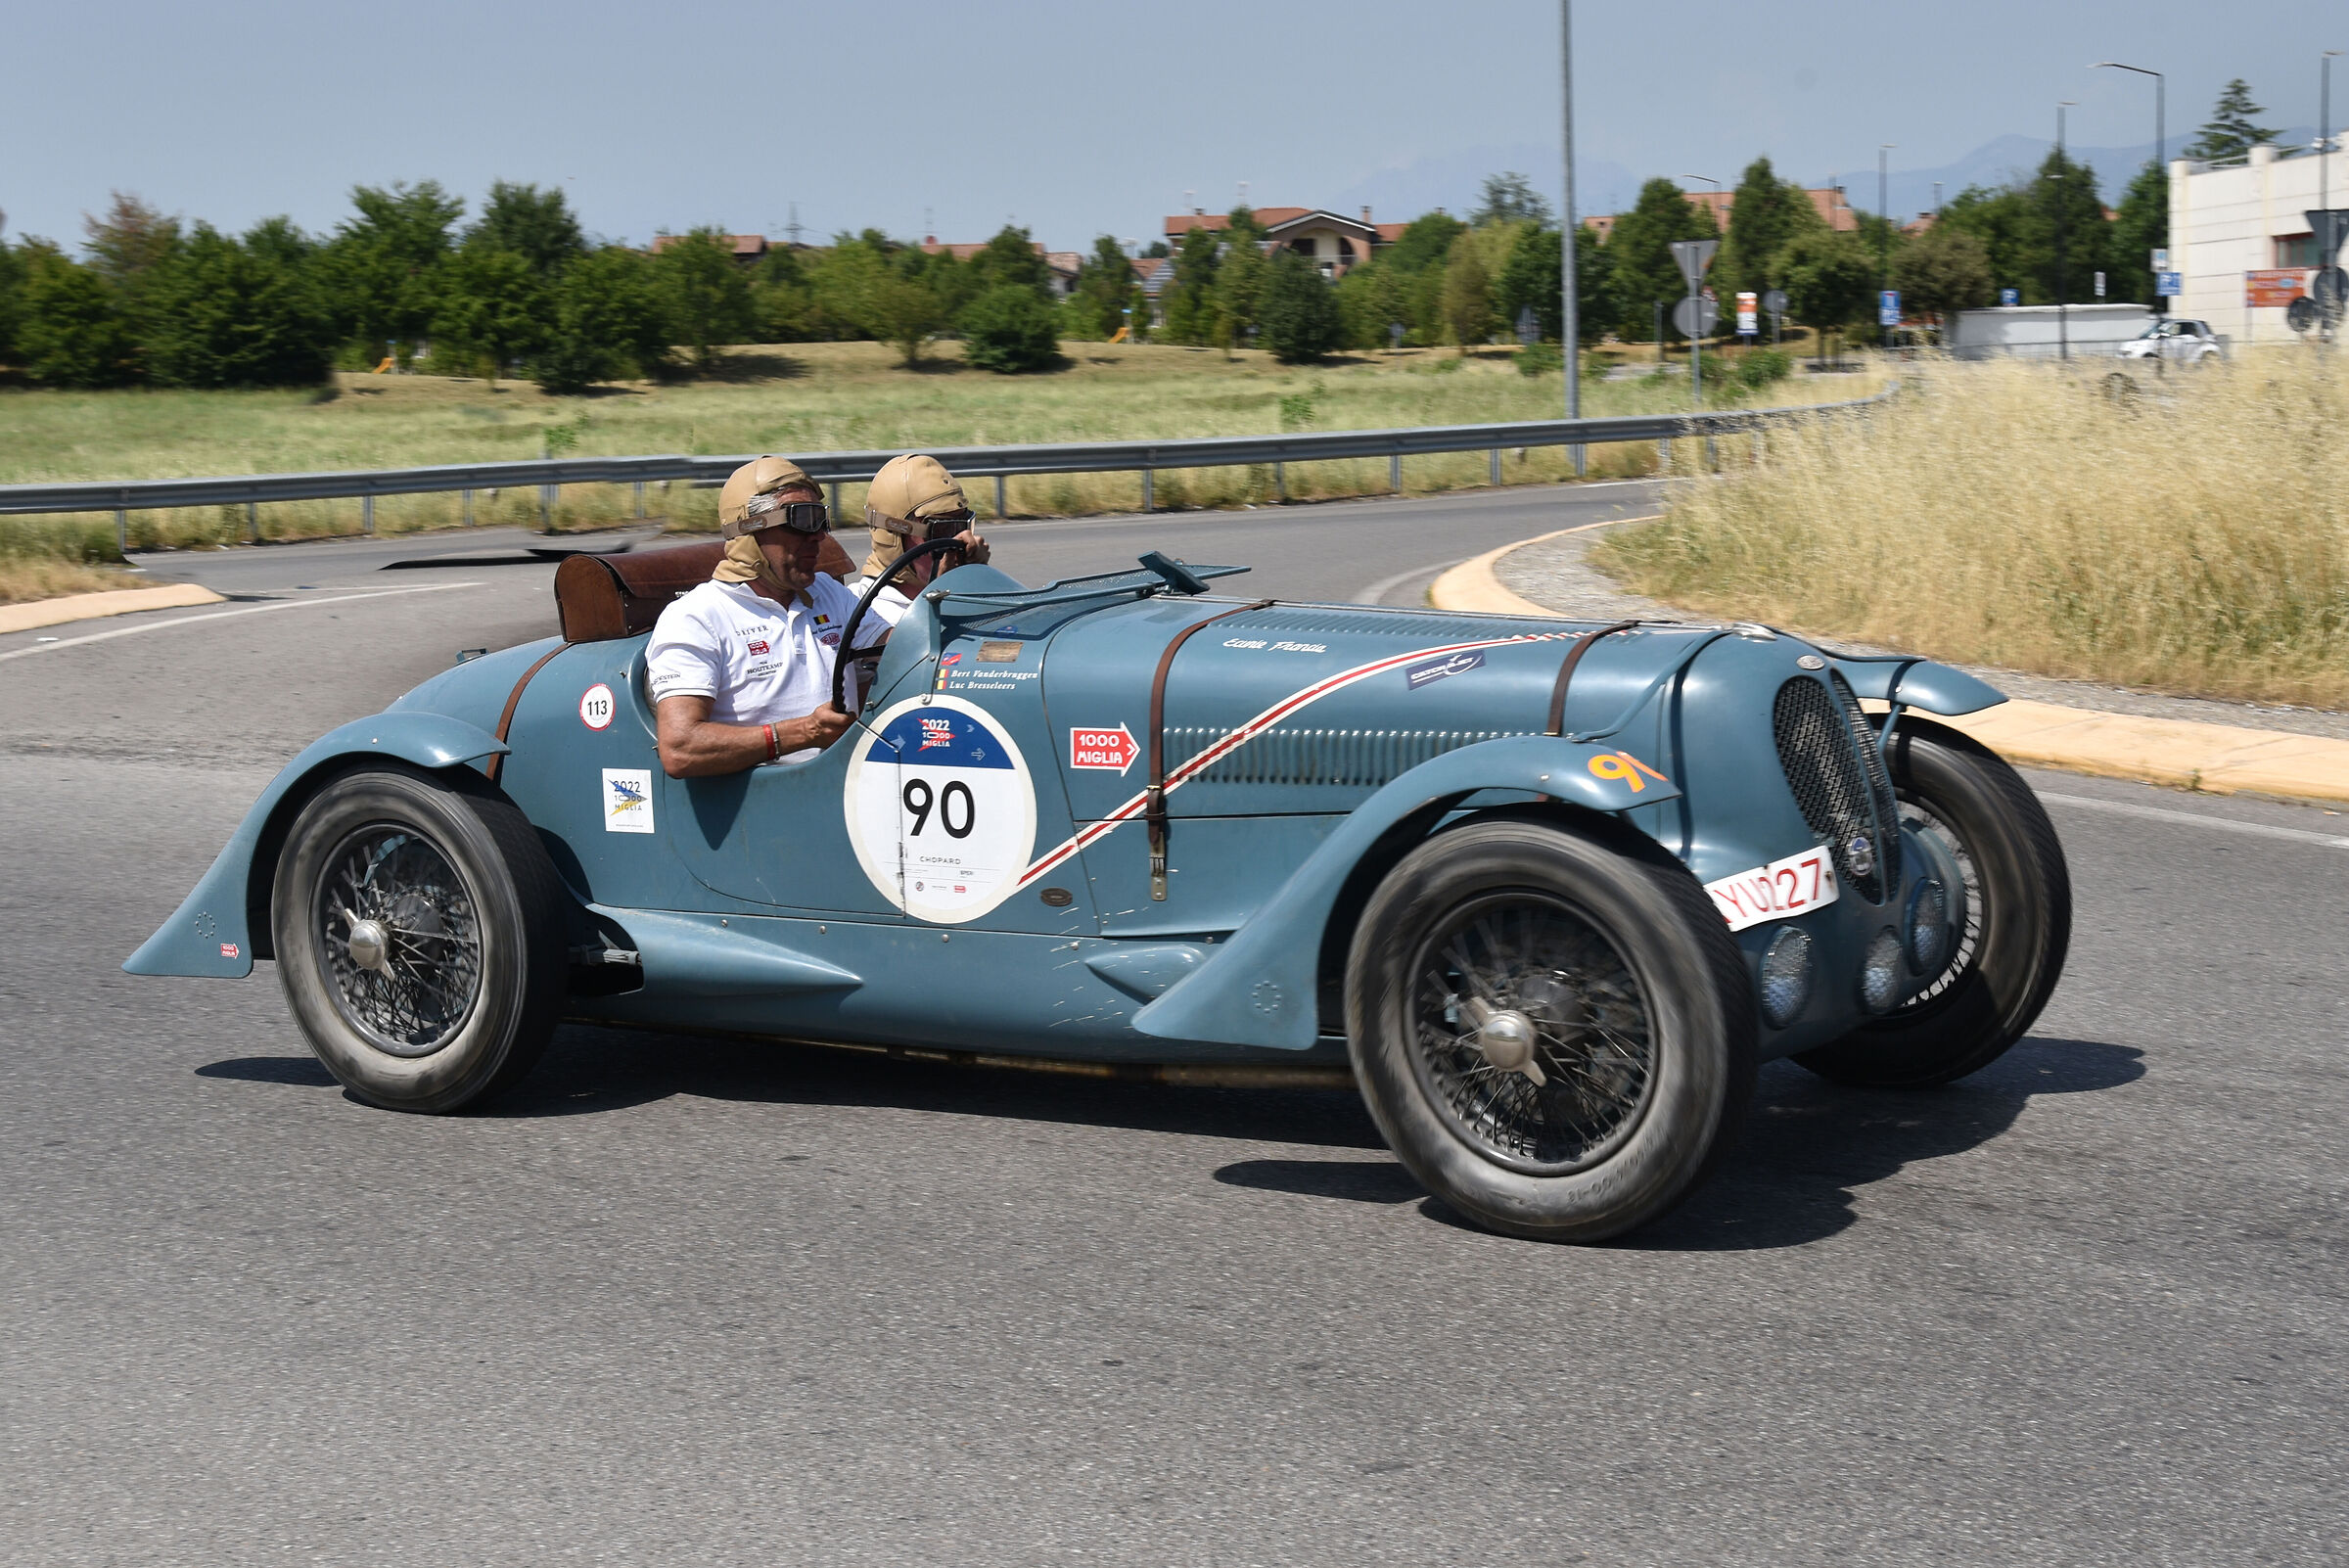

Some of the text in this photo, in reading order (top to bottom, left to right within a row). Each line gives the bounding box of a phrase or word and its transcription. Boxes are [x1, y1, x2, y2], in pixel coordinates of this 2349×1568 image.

[735, 625, 769, 636] DRIVER
[973, 669, 1038, 680] Vanderbruggen
[967, 681, 1016, 690] Bresseleers
[587, 700, 608, 715] 113
[922, 718, 950, 731] 2022
[1079, 734, 1120, 747] 1000
[1077, 751, 1124, 764] MIGLIA
[614, 780, 641, 793] 2022
[903, 778, 975, 839] 90
[919, 855, 961, 865] CHOPARD
